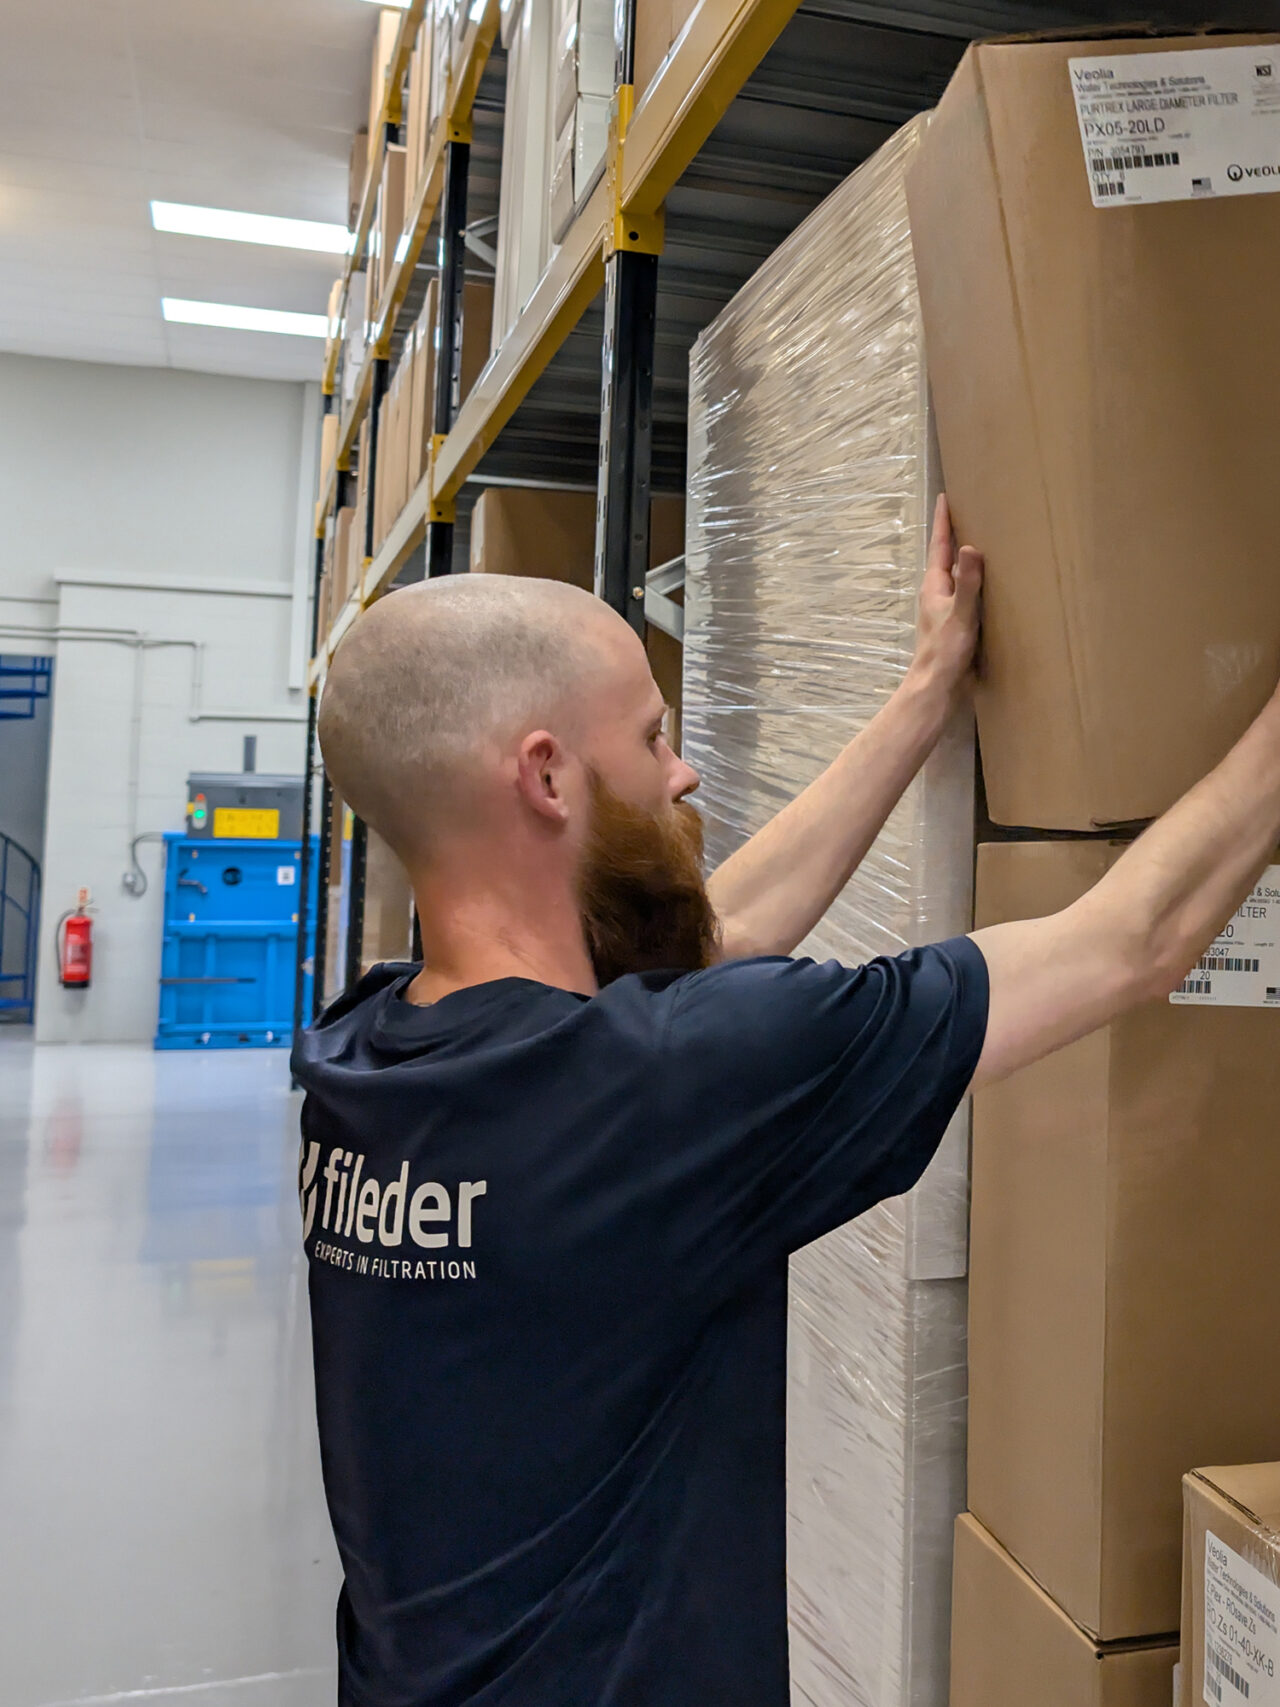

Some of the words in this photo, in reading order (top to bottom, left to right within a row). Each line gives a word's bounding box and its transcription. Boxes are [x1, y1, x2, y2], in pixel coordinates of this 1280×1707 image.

[1074, 69, 1114, 81] Veolia
[1080, 101, 1124, 116] PURTREX
[1126, 98, 1158, 113] LARGE
[1160, 96, 1205, 110] DIAMETER
[1208, 93, 1238, 106] FILTER
[1084, 118, 1165, 137] PX05-20LD
[1237, 906, 1267, 918] ILTER
[1200, 971, 1210, 980] 20
[322, 1147, 487, 1248] fileder
[314, 1240, 354, 1271] EXPERTS
[356, 1254, 368, 1275] IN
[371, 1258, 476, 1280] FILTRATION
[1208, 1538, 1228, 1566] Veolia
